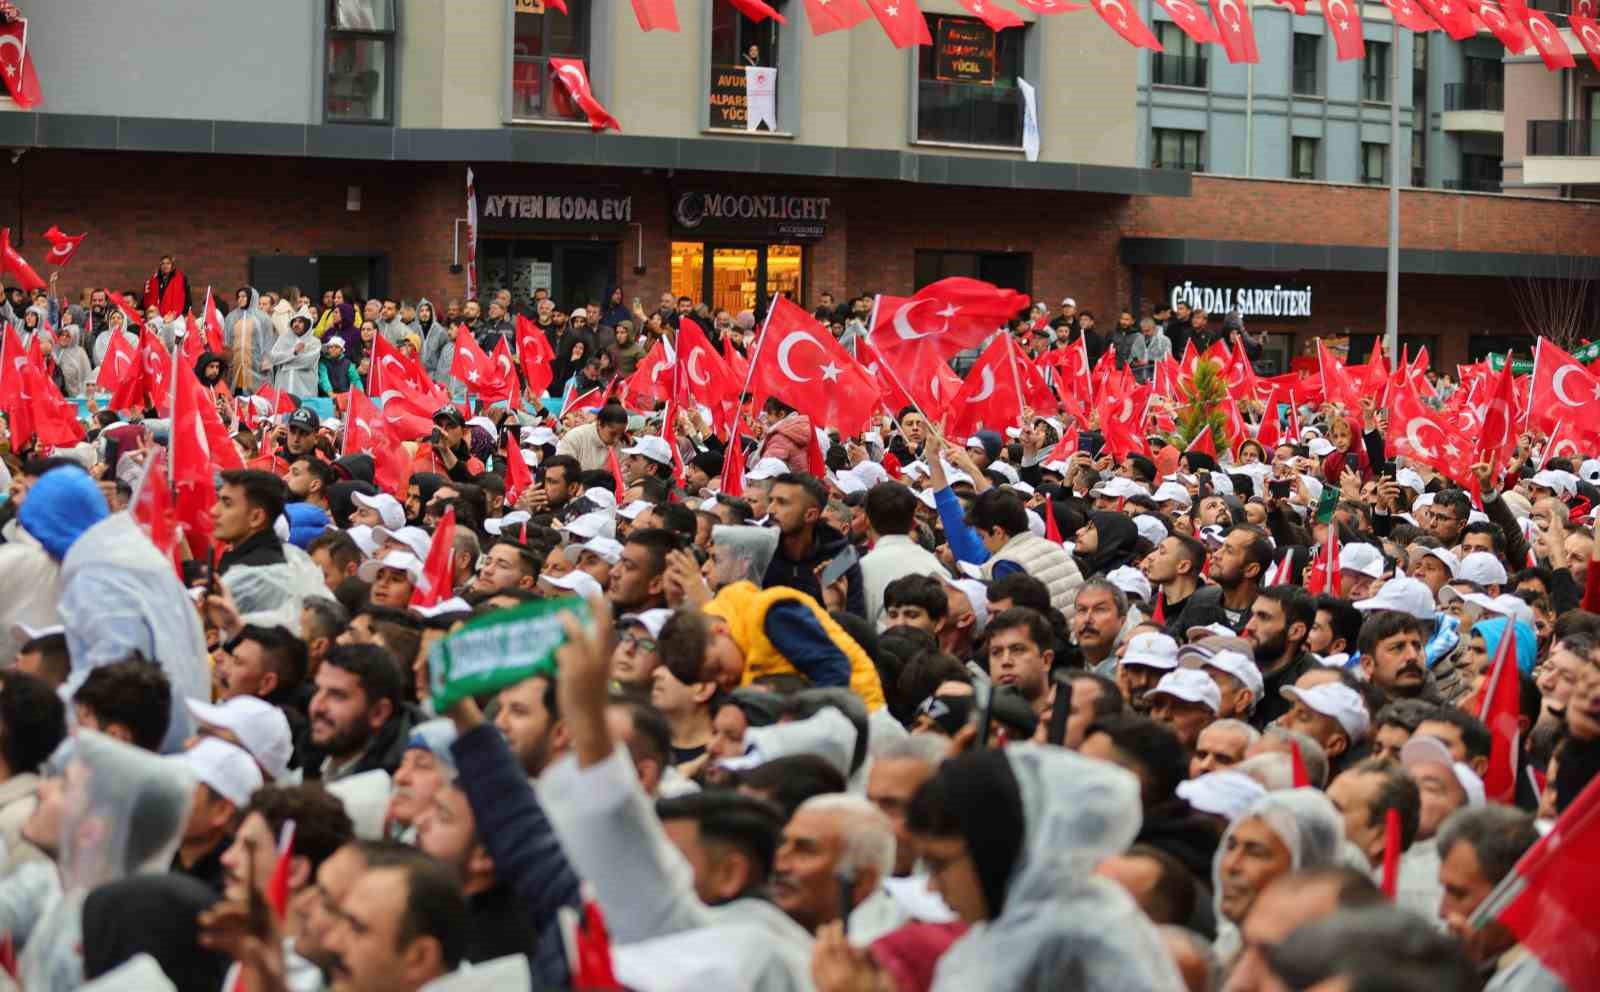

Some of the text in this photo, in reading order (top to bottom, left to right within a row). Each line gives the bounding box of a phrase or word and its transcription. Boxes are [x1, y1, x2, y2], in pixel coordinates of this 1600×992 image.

[484, 195, 543, 219] AYTEN
[703, 193, 830, 219] MOONLIGHT
[1172, 281, 1311, 318] GÖKDAL ŞARKÜTERİ
